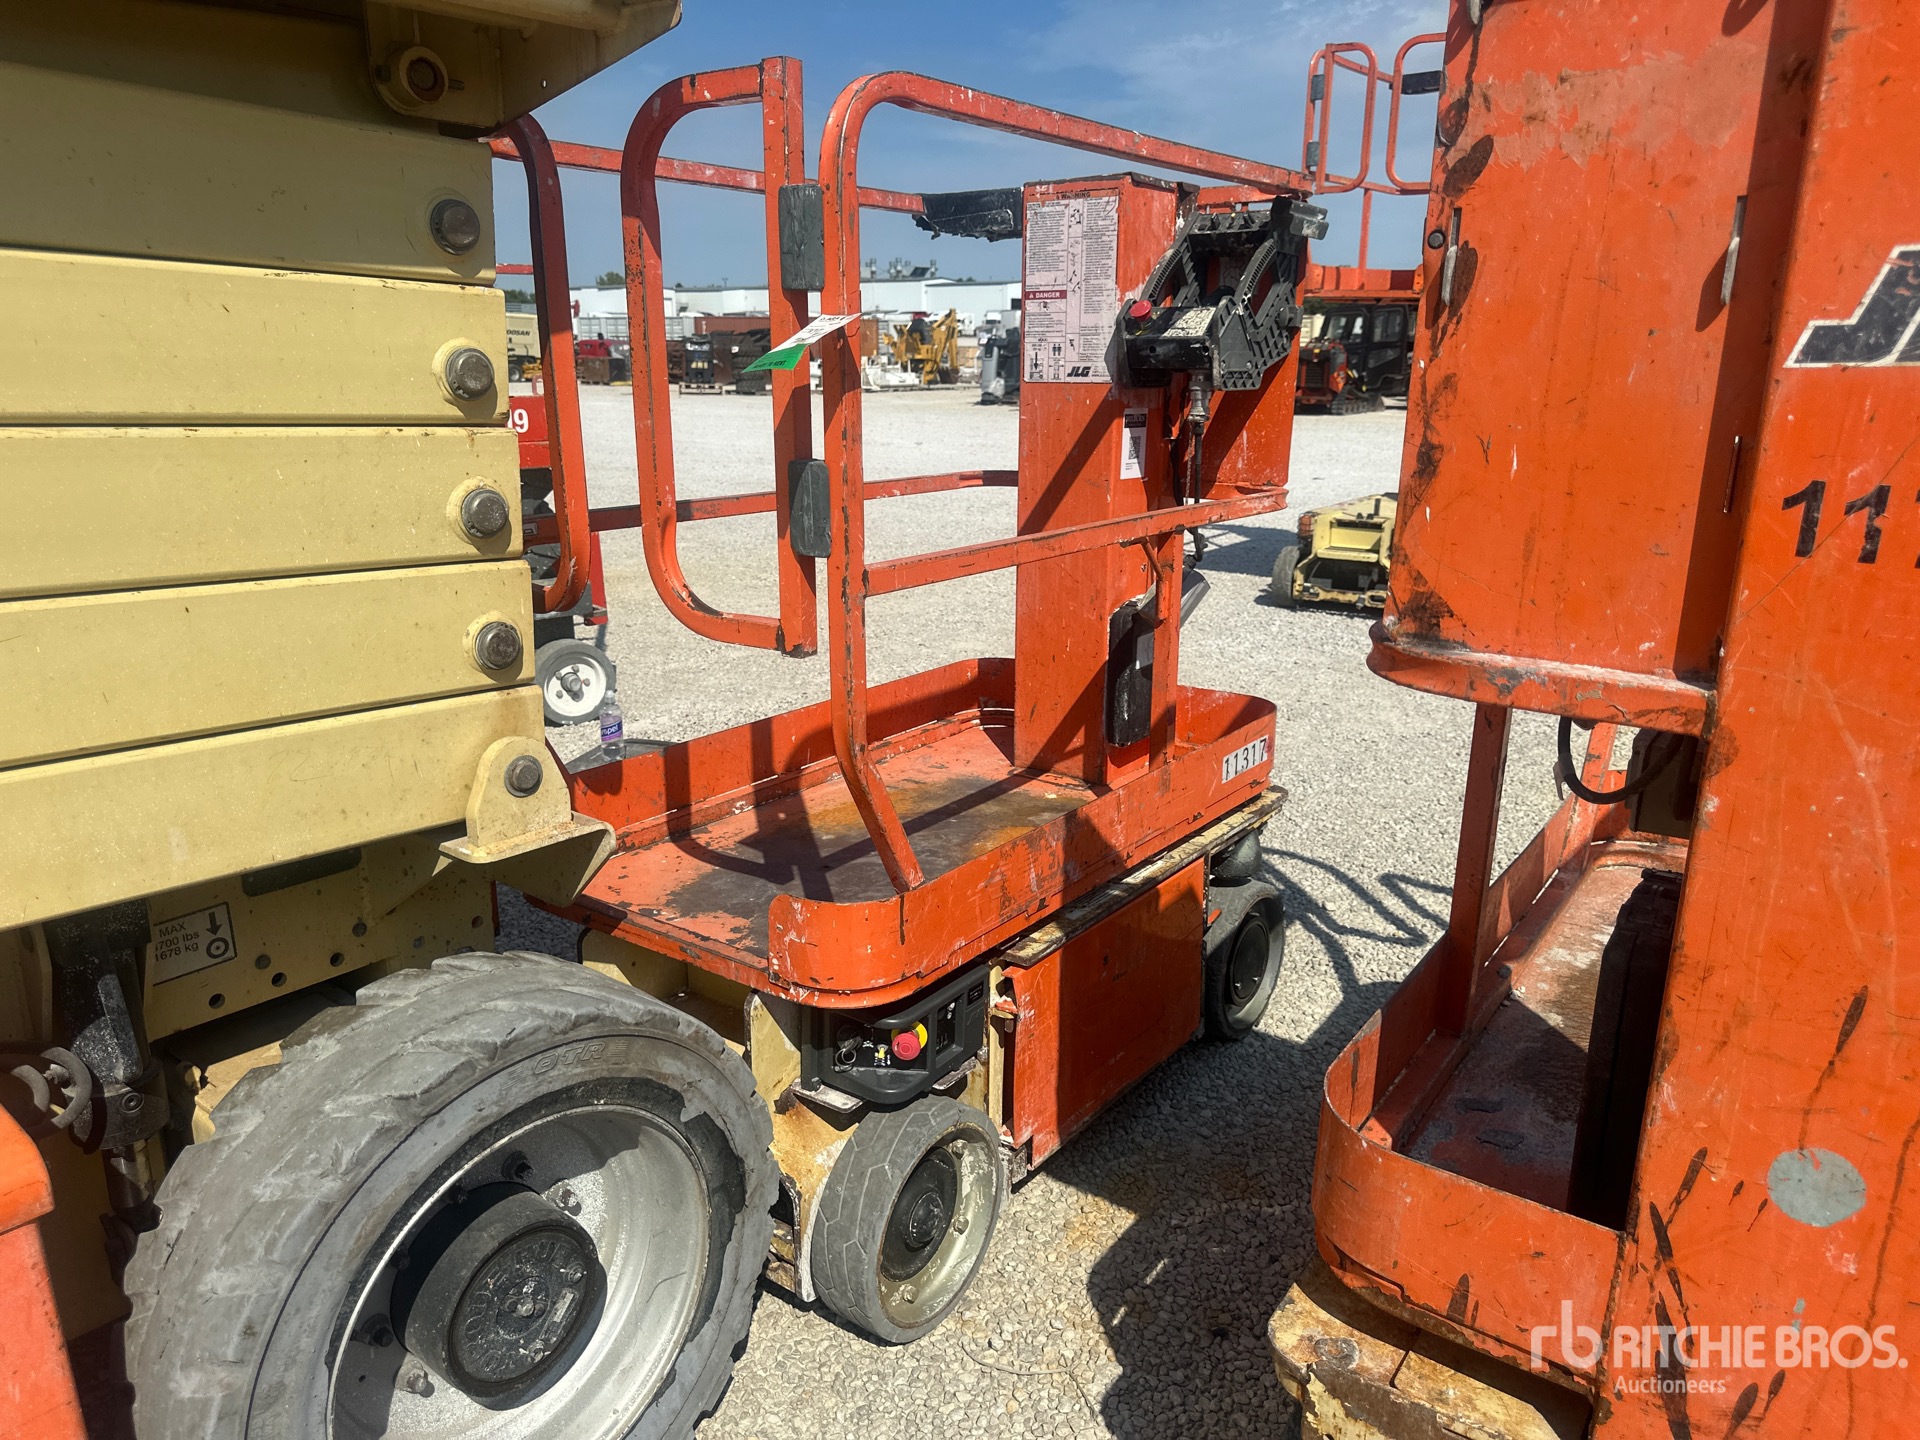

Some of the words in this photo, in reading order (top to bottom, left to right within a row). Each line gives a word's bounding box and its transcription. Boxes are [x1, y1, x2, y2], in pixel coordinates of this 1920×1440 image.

[1782, 243, 1920, 368] J
[1067, 366, 1092, 377] JLG
[1781, 479, 1920, 569] 11
[1224, 738, 1267, 781] 11317
[160, 921, 187, 938] MAX
[182, 931, 200, 943] lbs
[155, 946, 181, 962] 1678
[184, 942, 199, 952] kg
[533, 1041, 607, 1075] OTR
